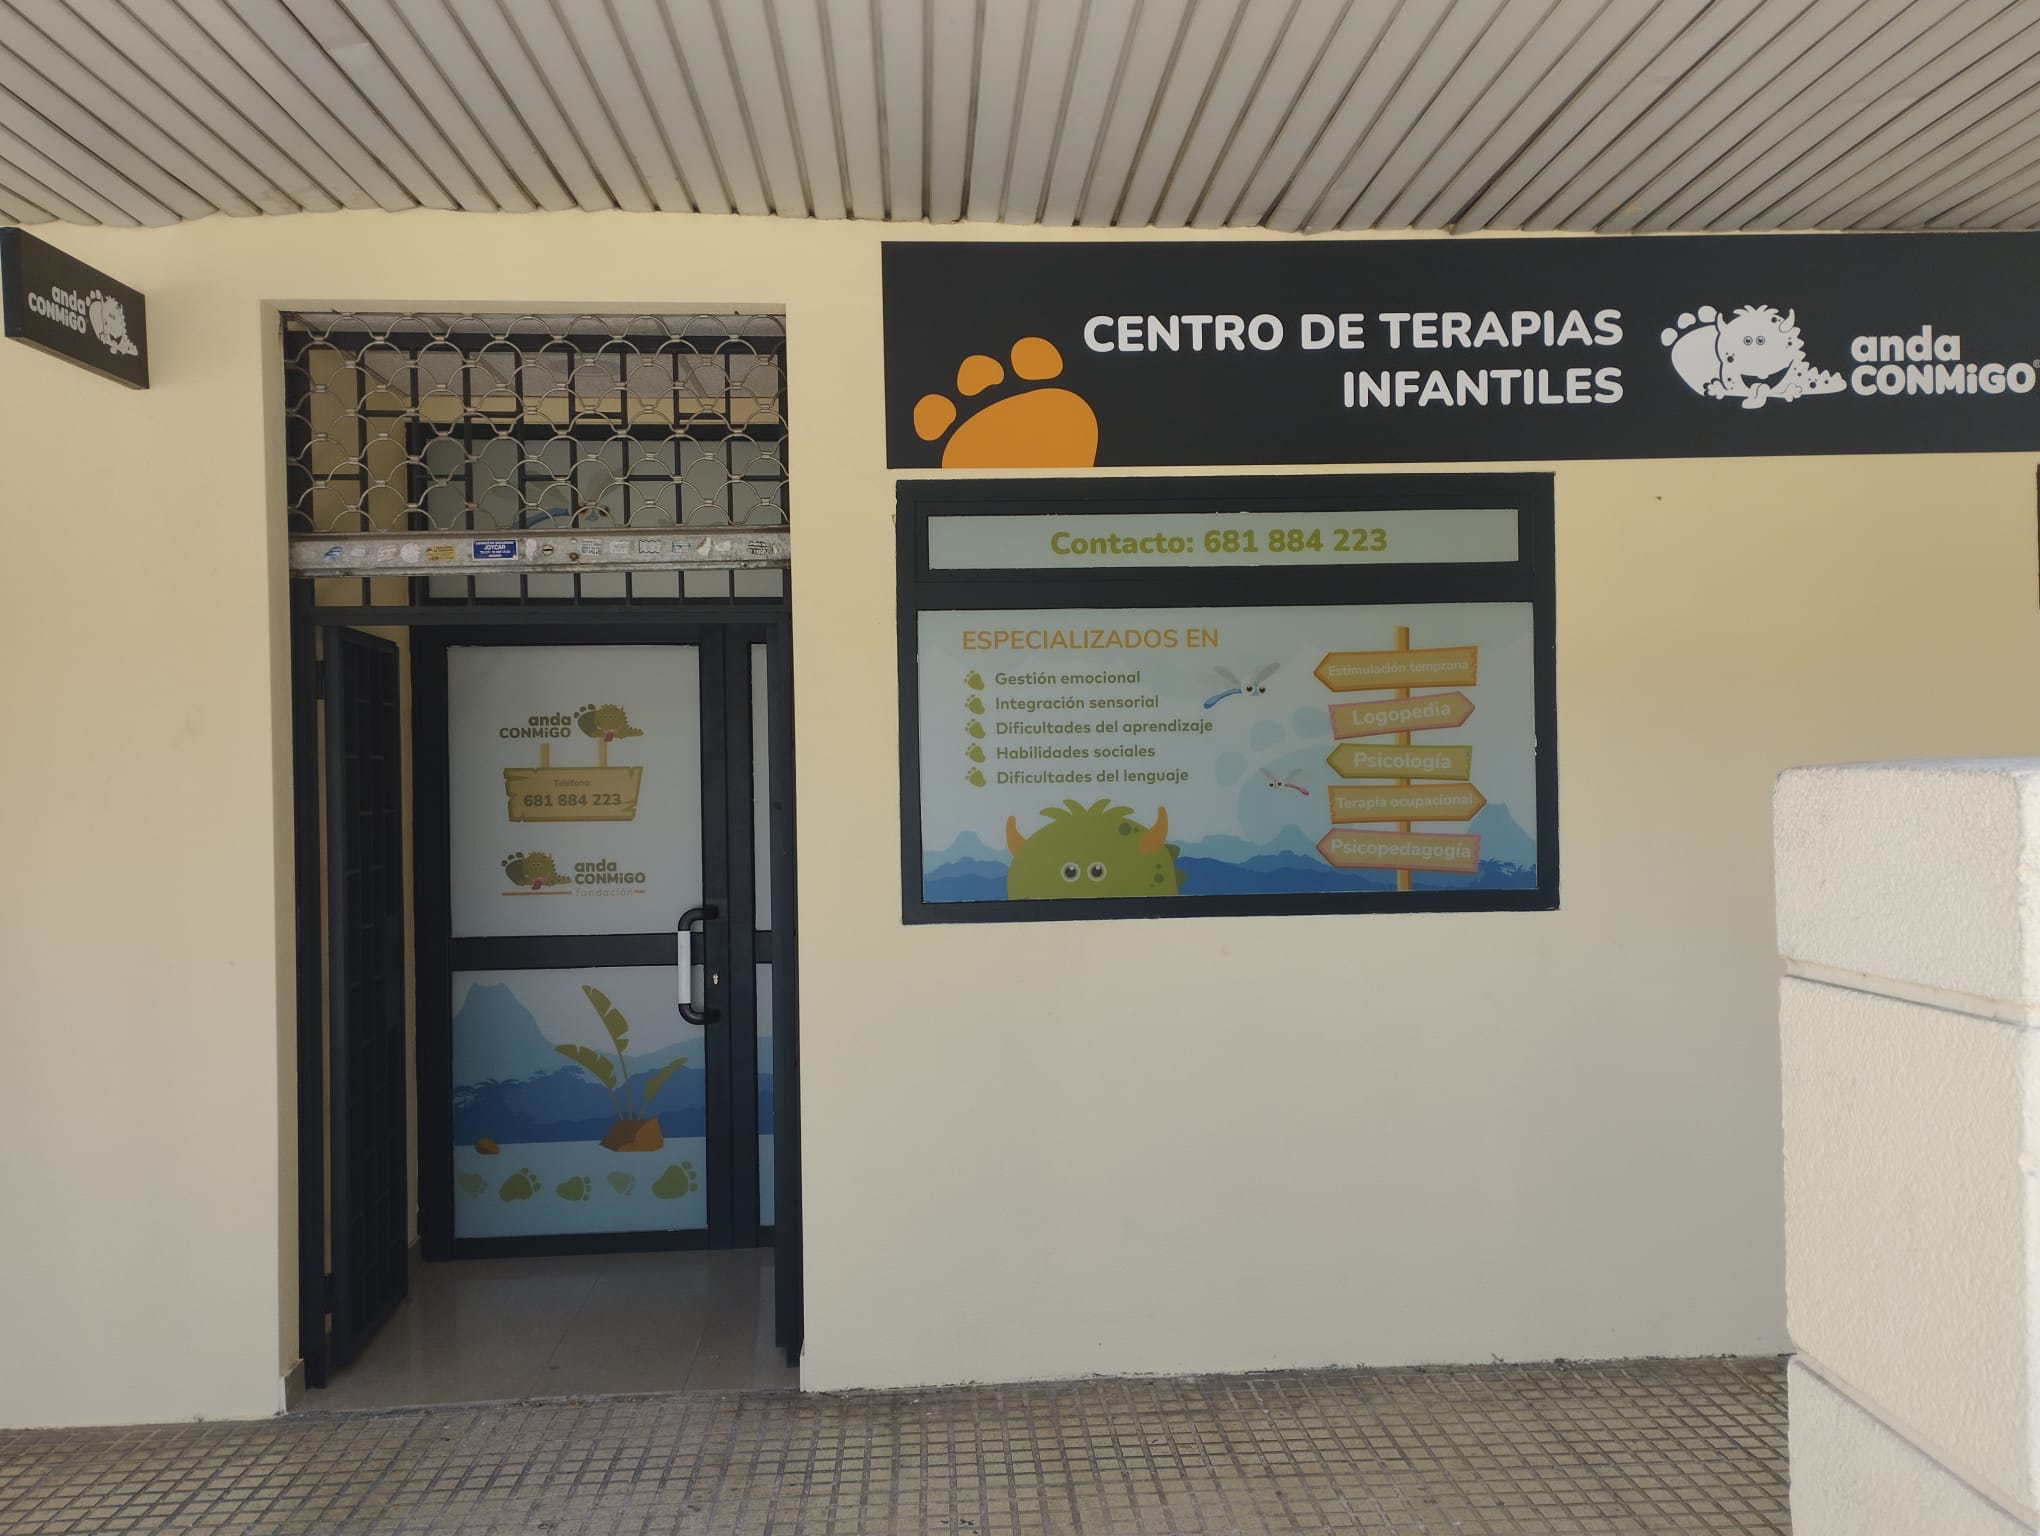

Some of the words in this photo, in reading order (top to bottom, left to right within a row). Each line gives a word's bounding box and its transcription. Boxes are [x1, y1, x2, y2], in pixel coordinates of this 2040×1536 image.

[52, 286, 86, 316] anda
[1083, 313, 1284, 352] CENTRO
[1301, 313, 1366, 350] DE
[1378, 309, 1624, 349] TERAPIAS
[1851, 325, 1961, 362] anda
[1343, 367, 1624, 408] INFANTILES
[1051, 531, 1194, 555] Contacto:
[1204, 530, 1259, 553] 681
[1268, 529, 1323, 552] 884
[1333, 528, 1388, 551] 223
[963, 629, 1179, 650] ESPECIALIZADOS
[1186, 628, 1219, 648] EN
[1327, 663, 1407, 677] Estimulación
[1410, 659, 1469, 674] temprana
[994, 671, 1057, 686] Gestión
[1060, 670, 1141, 684] emocional
[995, 696, 1085, 713] Integración
[1089, 695, 1159, 709] sensorial
[528, 712, 572, 726] anda
[1352, 702, 1451, 726] Logopedia
[996, 720, 1092, 736] Dificultades
[1095, 720, 1119, 734] del
[1122, 718, 1214, 736] aprendizaje
[996, 745, 1090, 760] Habilidades
[1093, 744, 1156, 758] sociales
[1354, 751, 1452, 772] Psicología
[996, 770, 1093, 785] Dificultades
[1096, 769, 1120, 784] del
[1123, 768, 1190, 785] lenguaje
[523, 794, 553, 808] 681
[557, 793, 588, 807] 884
[592, 793, 622, 806] 223
[1336, 796, 1388, 812] Terapia
[1390, 793, 1473, 809] ocupacional
[1331, 839, 1472, 860] Psicopedagogía
[575, 858, 617, 872] anda
